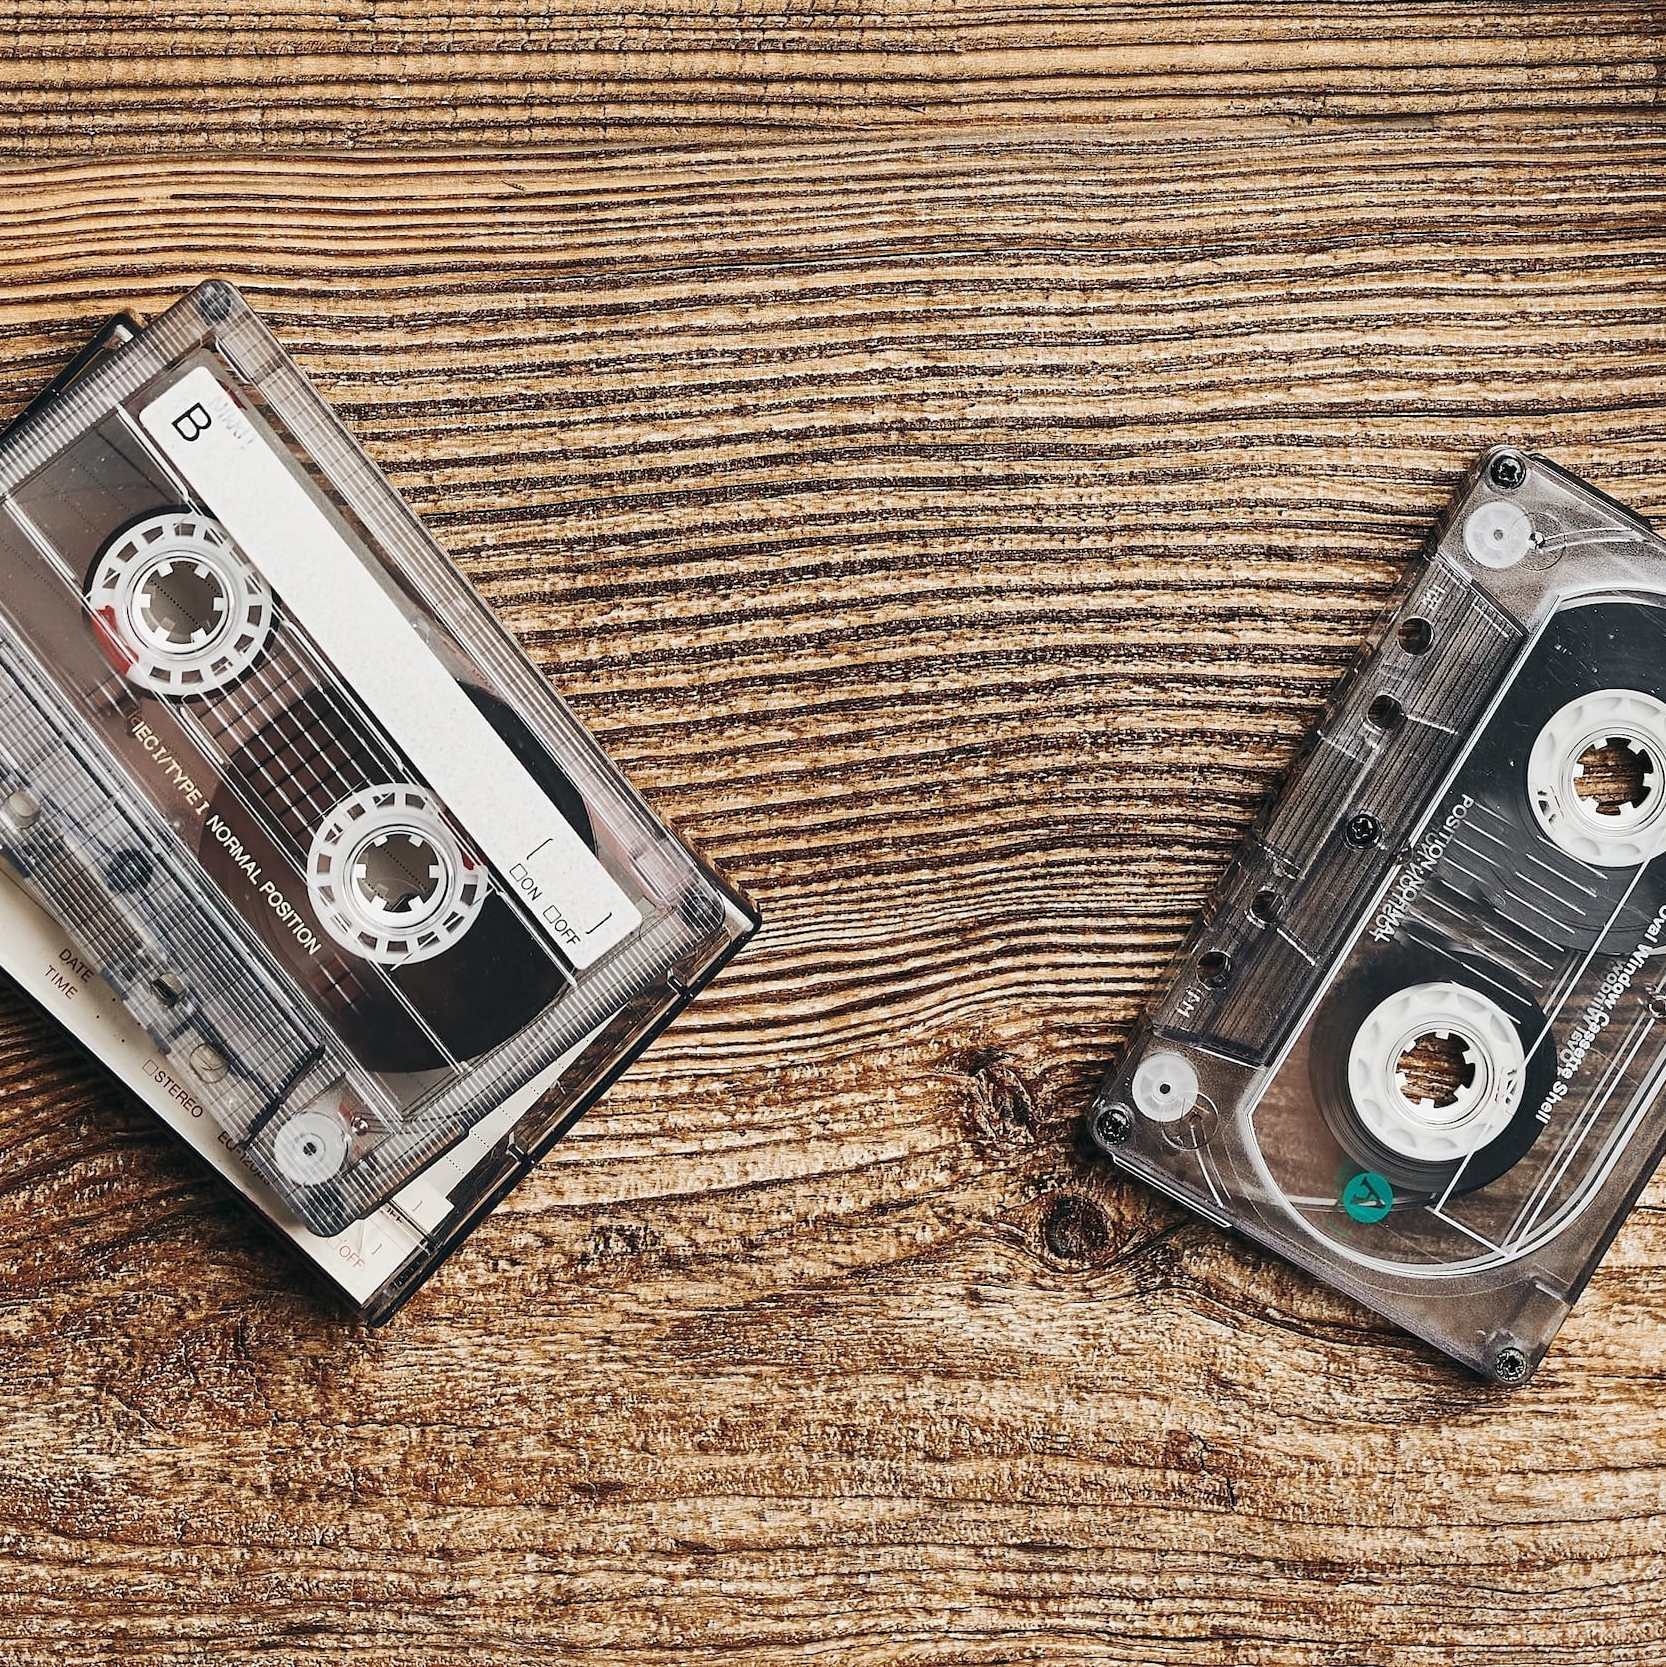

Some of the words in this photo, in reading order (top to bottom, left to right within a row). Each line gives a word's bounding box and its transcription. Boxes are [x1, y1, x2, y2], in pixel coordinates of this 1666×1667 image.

[172, 403, 212, 441] B
[205, 813, 263, 886] NORMAL
[259, 880, 323, 957] POSITION
[521, 878, 543, 901] ON
[555, 920, 582, 945] OFF
[43, 964, 79, 1001] TIME
[58, 948, 94, 983] DATE
[1601, 943, 1655, 1010] Window
[1559, 1012, 1610, 1081] Cassette
[154, 1070, 204, 1119] STEREO
[1534, 1082, 1569, 1125] Shell
[1349, 1177, 1387, 1209] A
[339, 1244, 365, 1269] OFF
